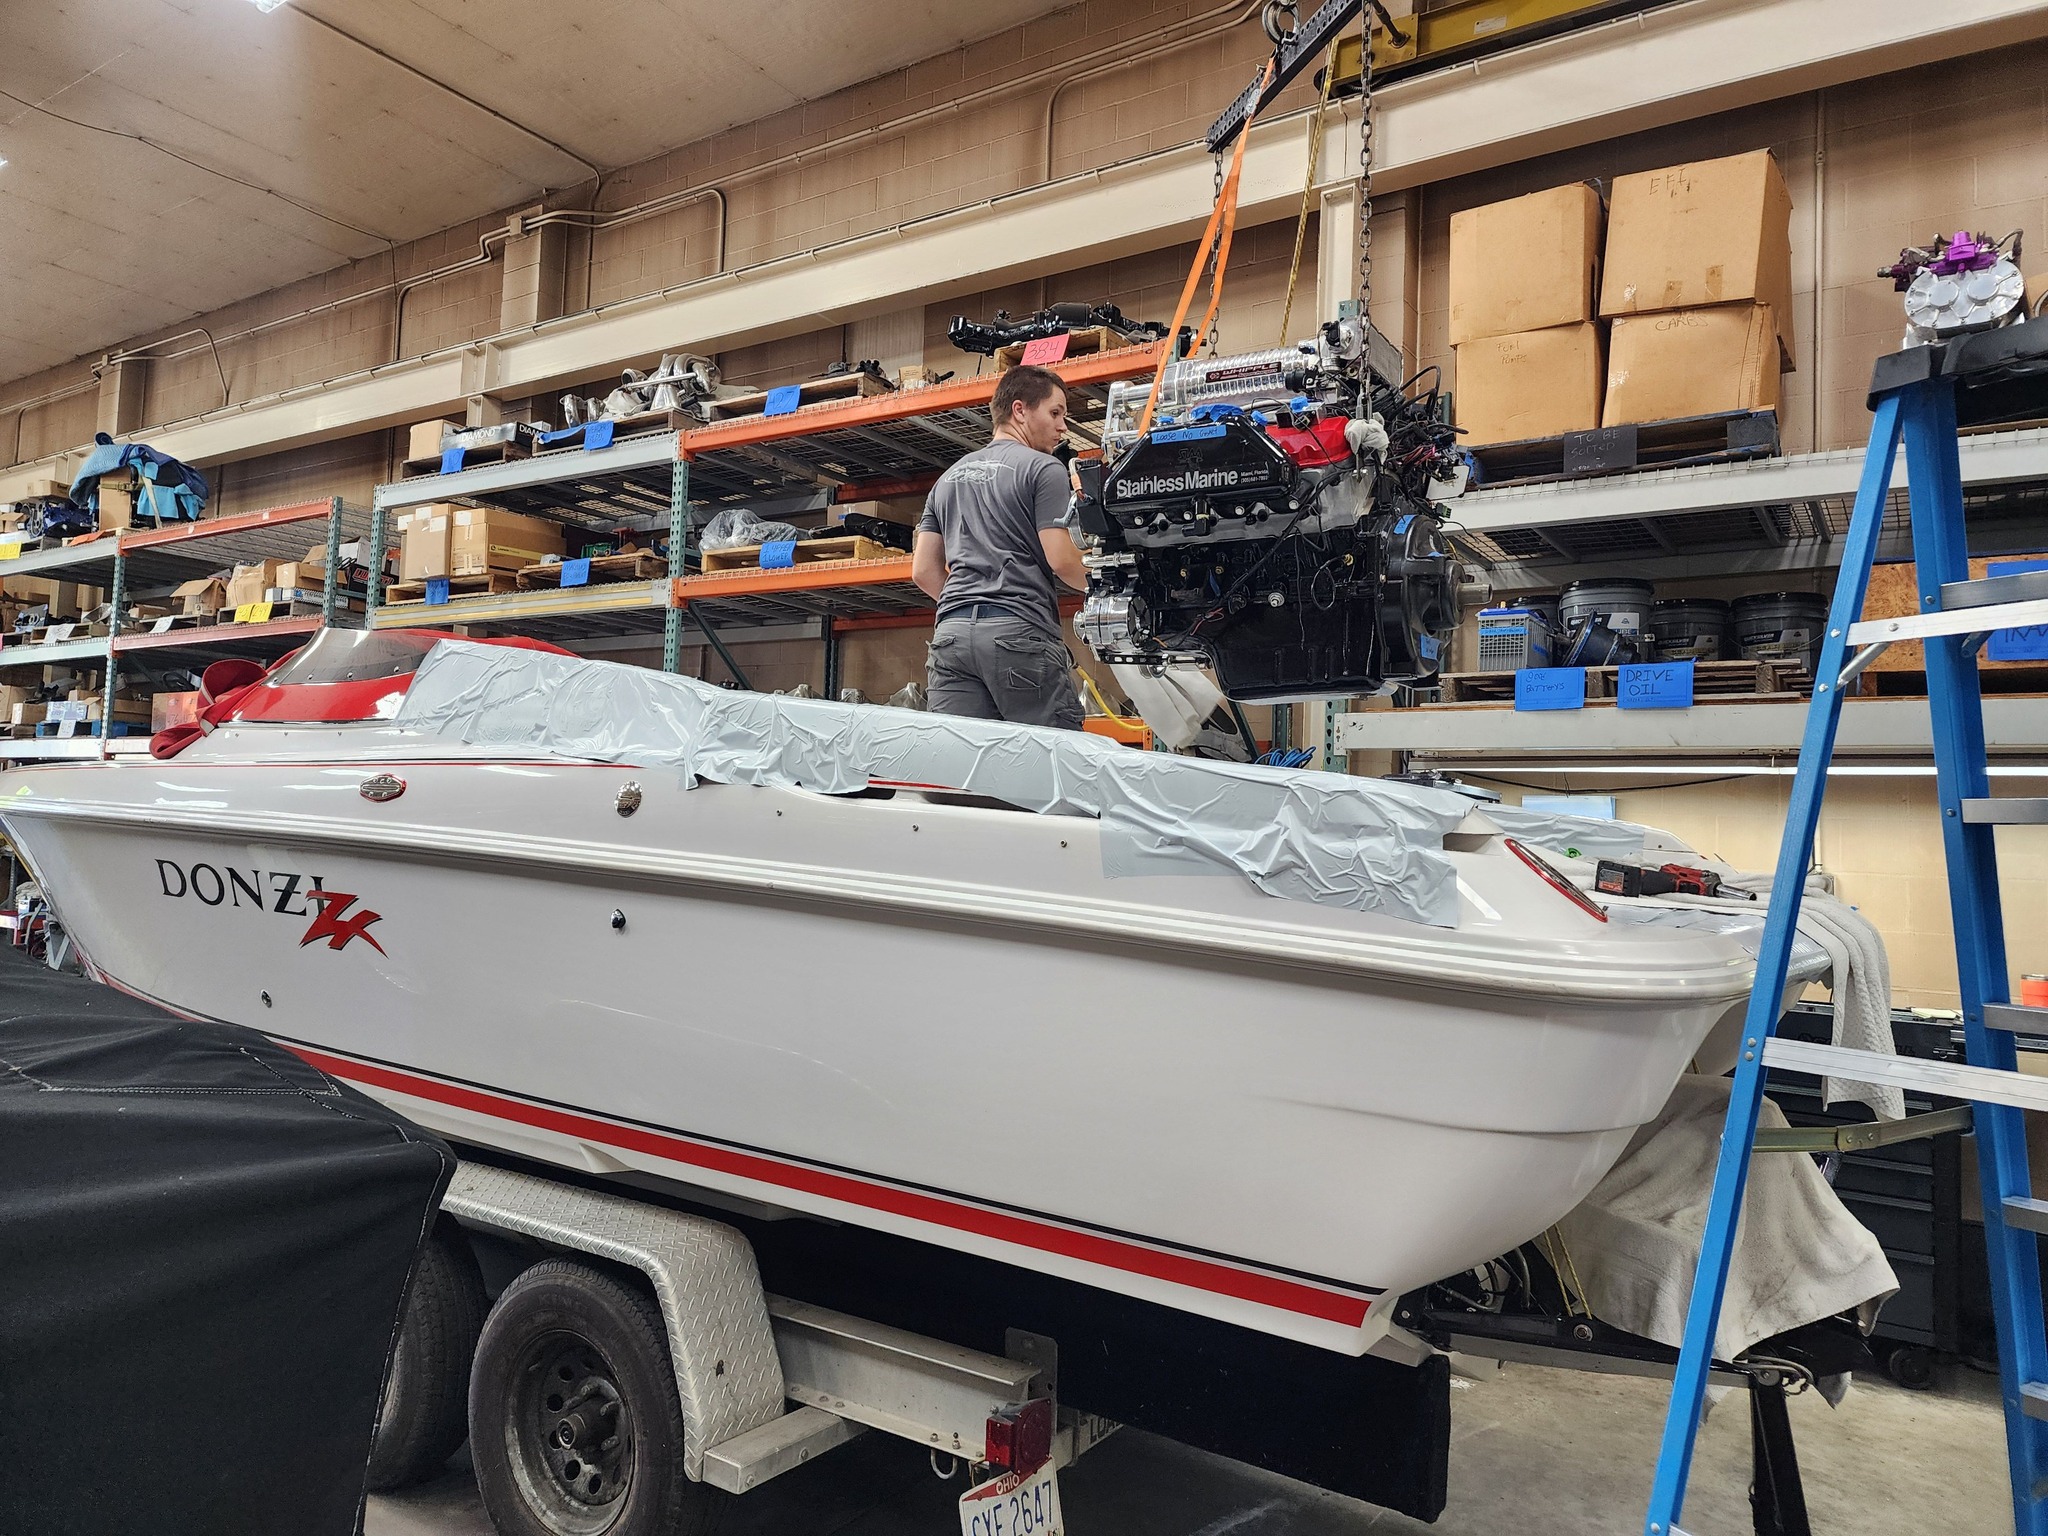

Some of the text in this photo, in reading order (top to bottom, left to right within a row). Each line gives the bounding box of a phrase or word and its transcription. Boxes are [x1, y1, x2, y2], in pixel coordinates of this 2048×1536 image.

[1222, 363, 1278, 375] WHIPPLE
[461, 428, 496, 443] DIAMOND
[519, 424, 540, 436] DIAM
[1183, 431, 1193, 440] No
[1574, 429, 1620, 445] TO BE
[1626, 669, 1674, 683] DRIVE
[1629, 684, 1661, 696] OIL
[154, 858, 328, 920] DONZI
[996, 1474, 1020, 1495] OHIO
[1010, 1480, 1052, 1536] 2647
